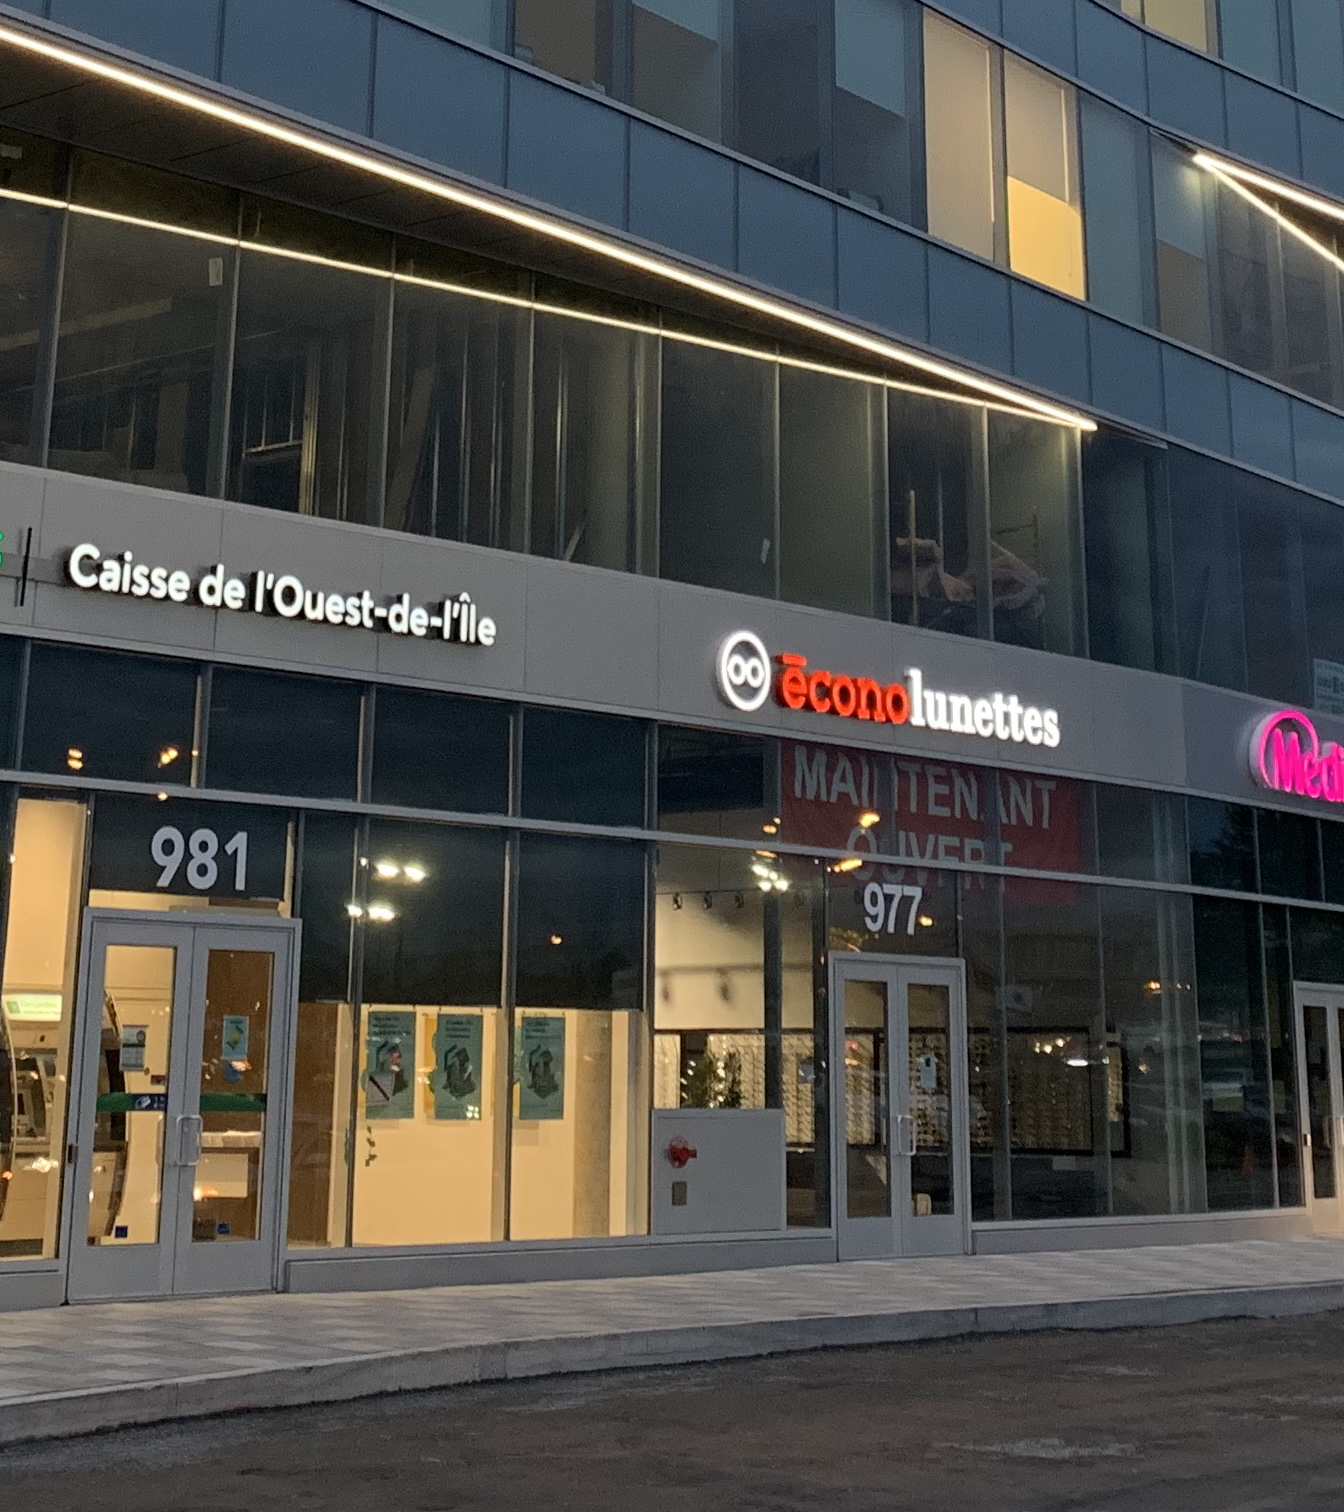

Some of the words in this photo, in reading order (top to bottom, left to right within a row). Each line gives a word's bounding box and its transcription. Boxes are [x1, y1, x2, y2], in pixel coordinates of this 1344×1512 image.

[67, 542, 191, 604] Caisse
[198, 563, 246, 611] de
[253, 569, 498, 647] l'Ouest-de-l'Île
[150, 825, 249, 891] 981
[862, 881, 924, 937] 977
